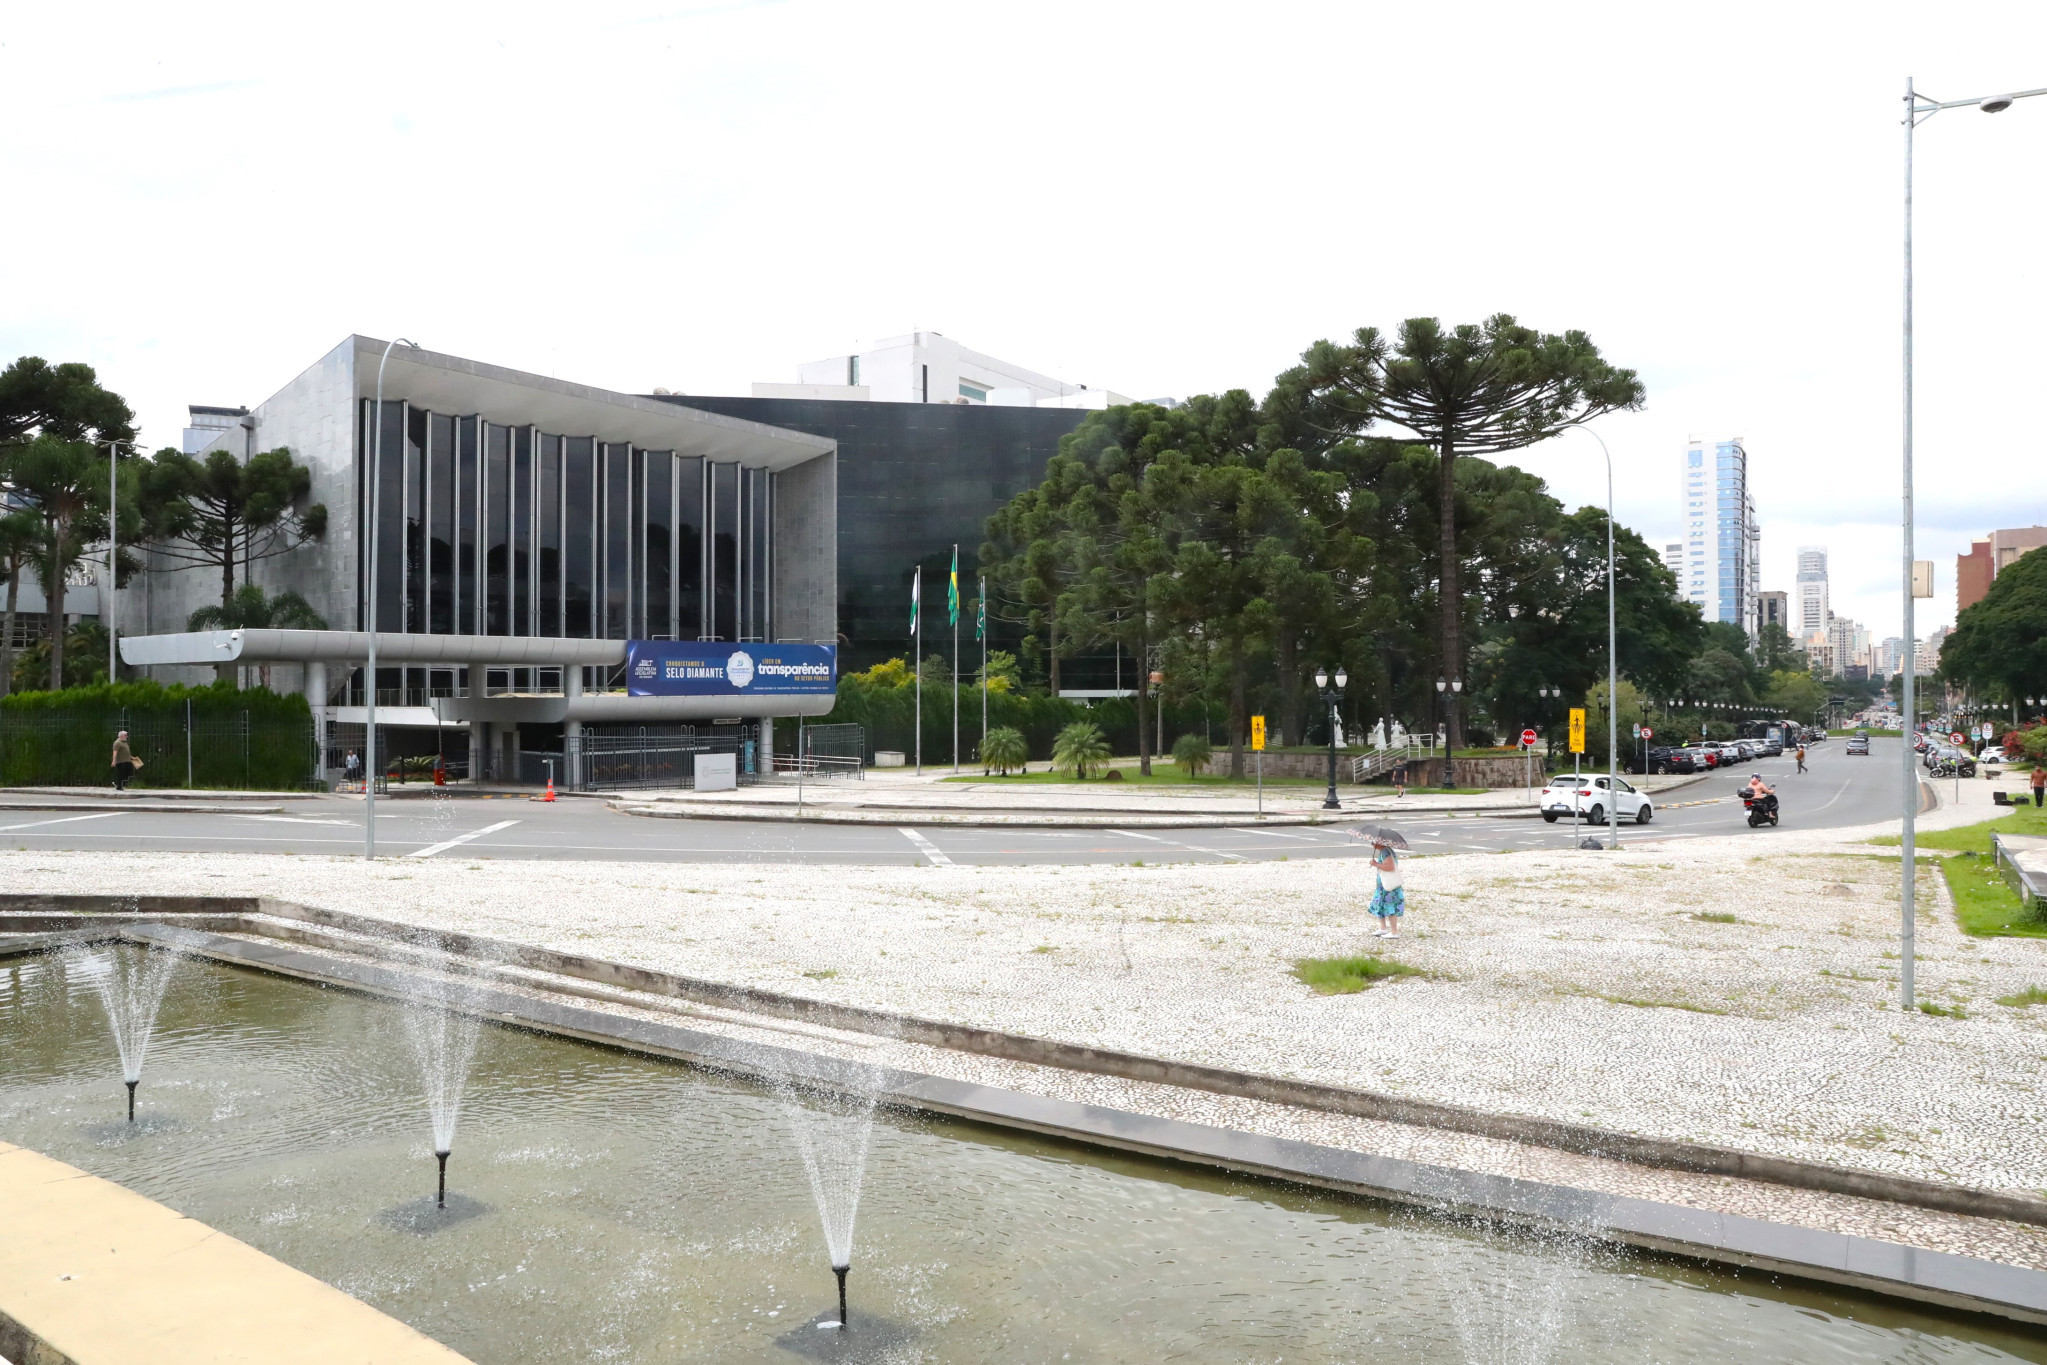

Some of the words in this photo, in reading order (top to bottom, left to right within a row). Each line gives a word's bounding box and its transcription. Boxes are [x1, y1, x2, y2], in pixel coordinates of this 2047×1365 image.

[666, 667, 685, 679] SELO
[687, 667, 724, 679] DIAMANTE
[758, 662, 829, 677] transparência
